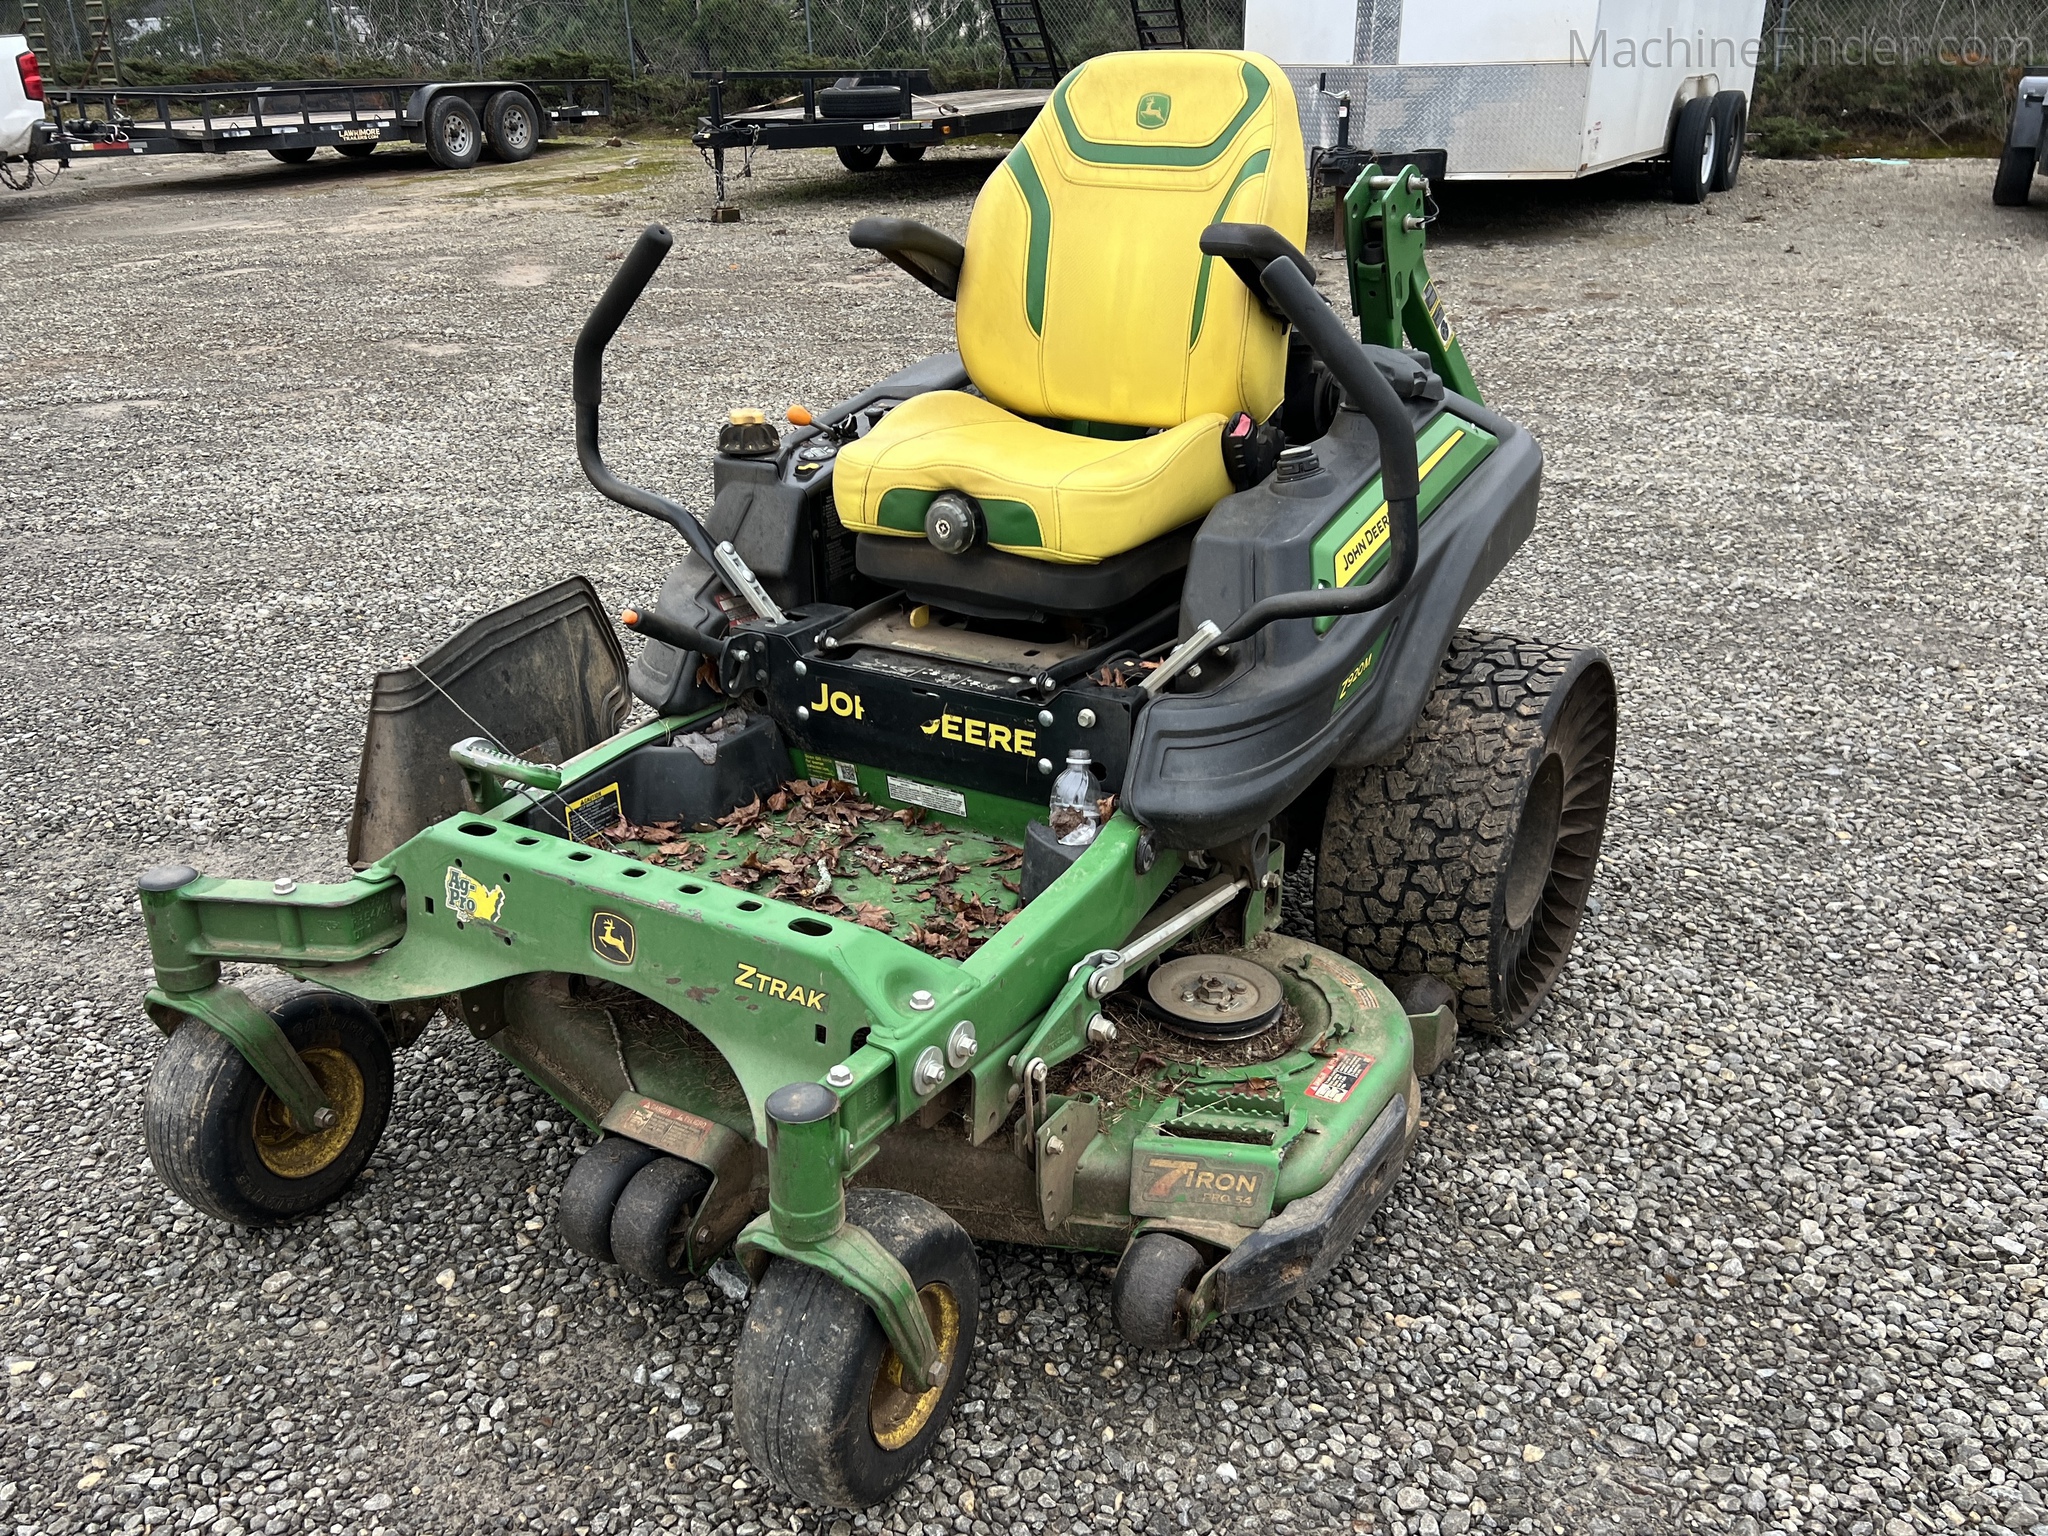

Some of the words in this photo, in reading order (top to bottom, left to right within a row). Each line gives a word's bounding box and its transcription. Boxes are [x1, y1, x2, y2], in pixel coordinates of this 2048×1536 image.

[1343, 538, 1367, 571] JOHN
[1364, 515, 1391, 546] DEER
[1339, 652, 1373, 700] Z920M
[449, 871, 475, 896] Ag-
[449, 889, 476, 911] Pro
[734, 962, 827, 1013] ZTRAK
[1203, 1192, 1231, 1203] PRO
[1235, 1194, 1253, 1206] 54
